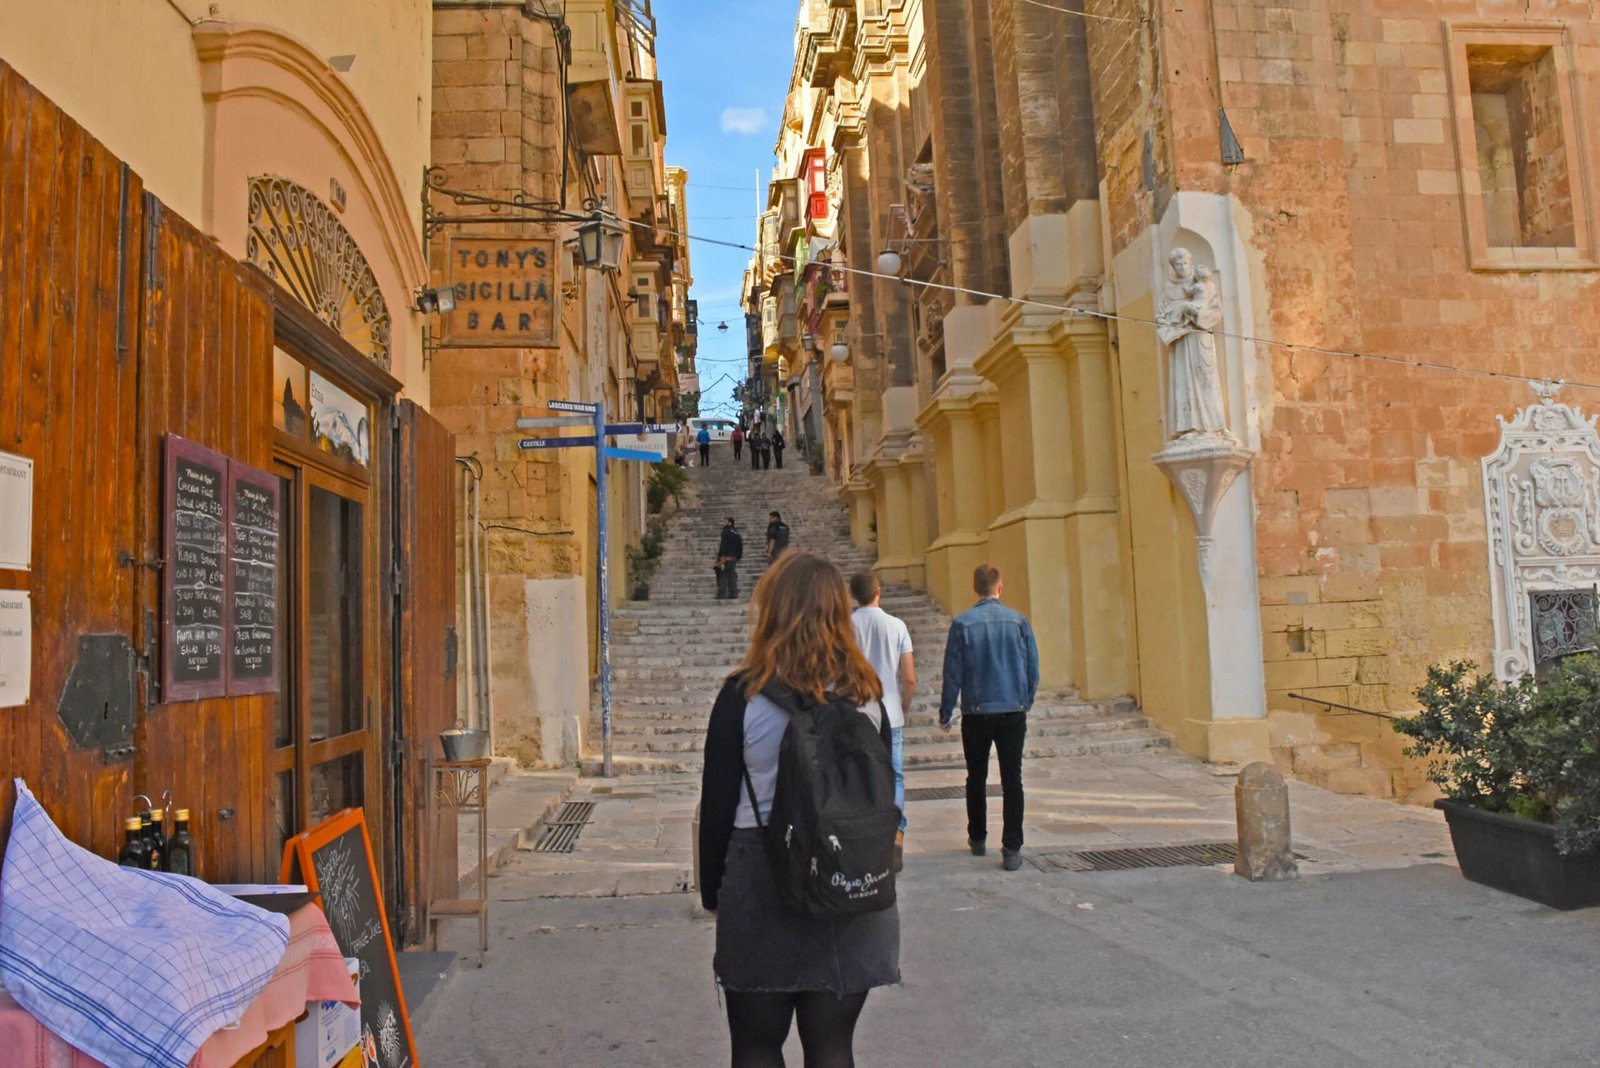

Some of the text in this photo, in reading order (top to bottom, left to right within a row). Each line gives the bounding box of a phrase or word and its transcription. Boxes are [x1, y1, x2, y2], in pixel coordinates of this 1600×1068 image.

[458, 247, 546, 268] TONY'S
[455, 281, 549, 301] SICILIA
[467, 312, 532, 331] BAR
[848, 889, 878, 899] LONDON
